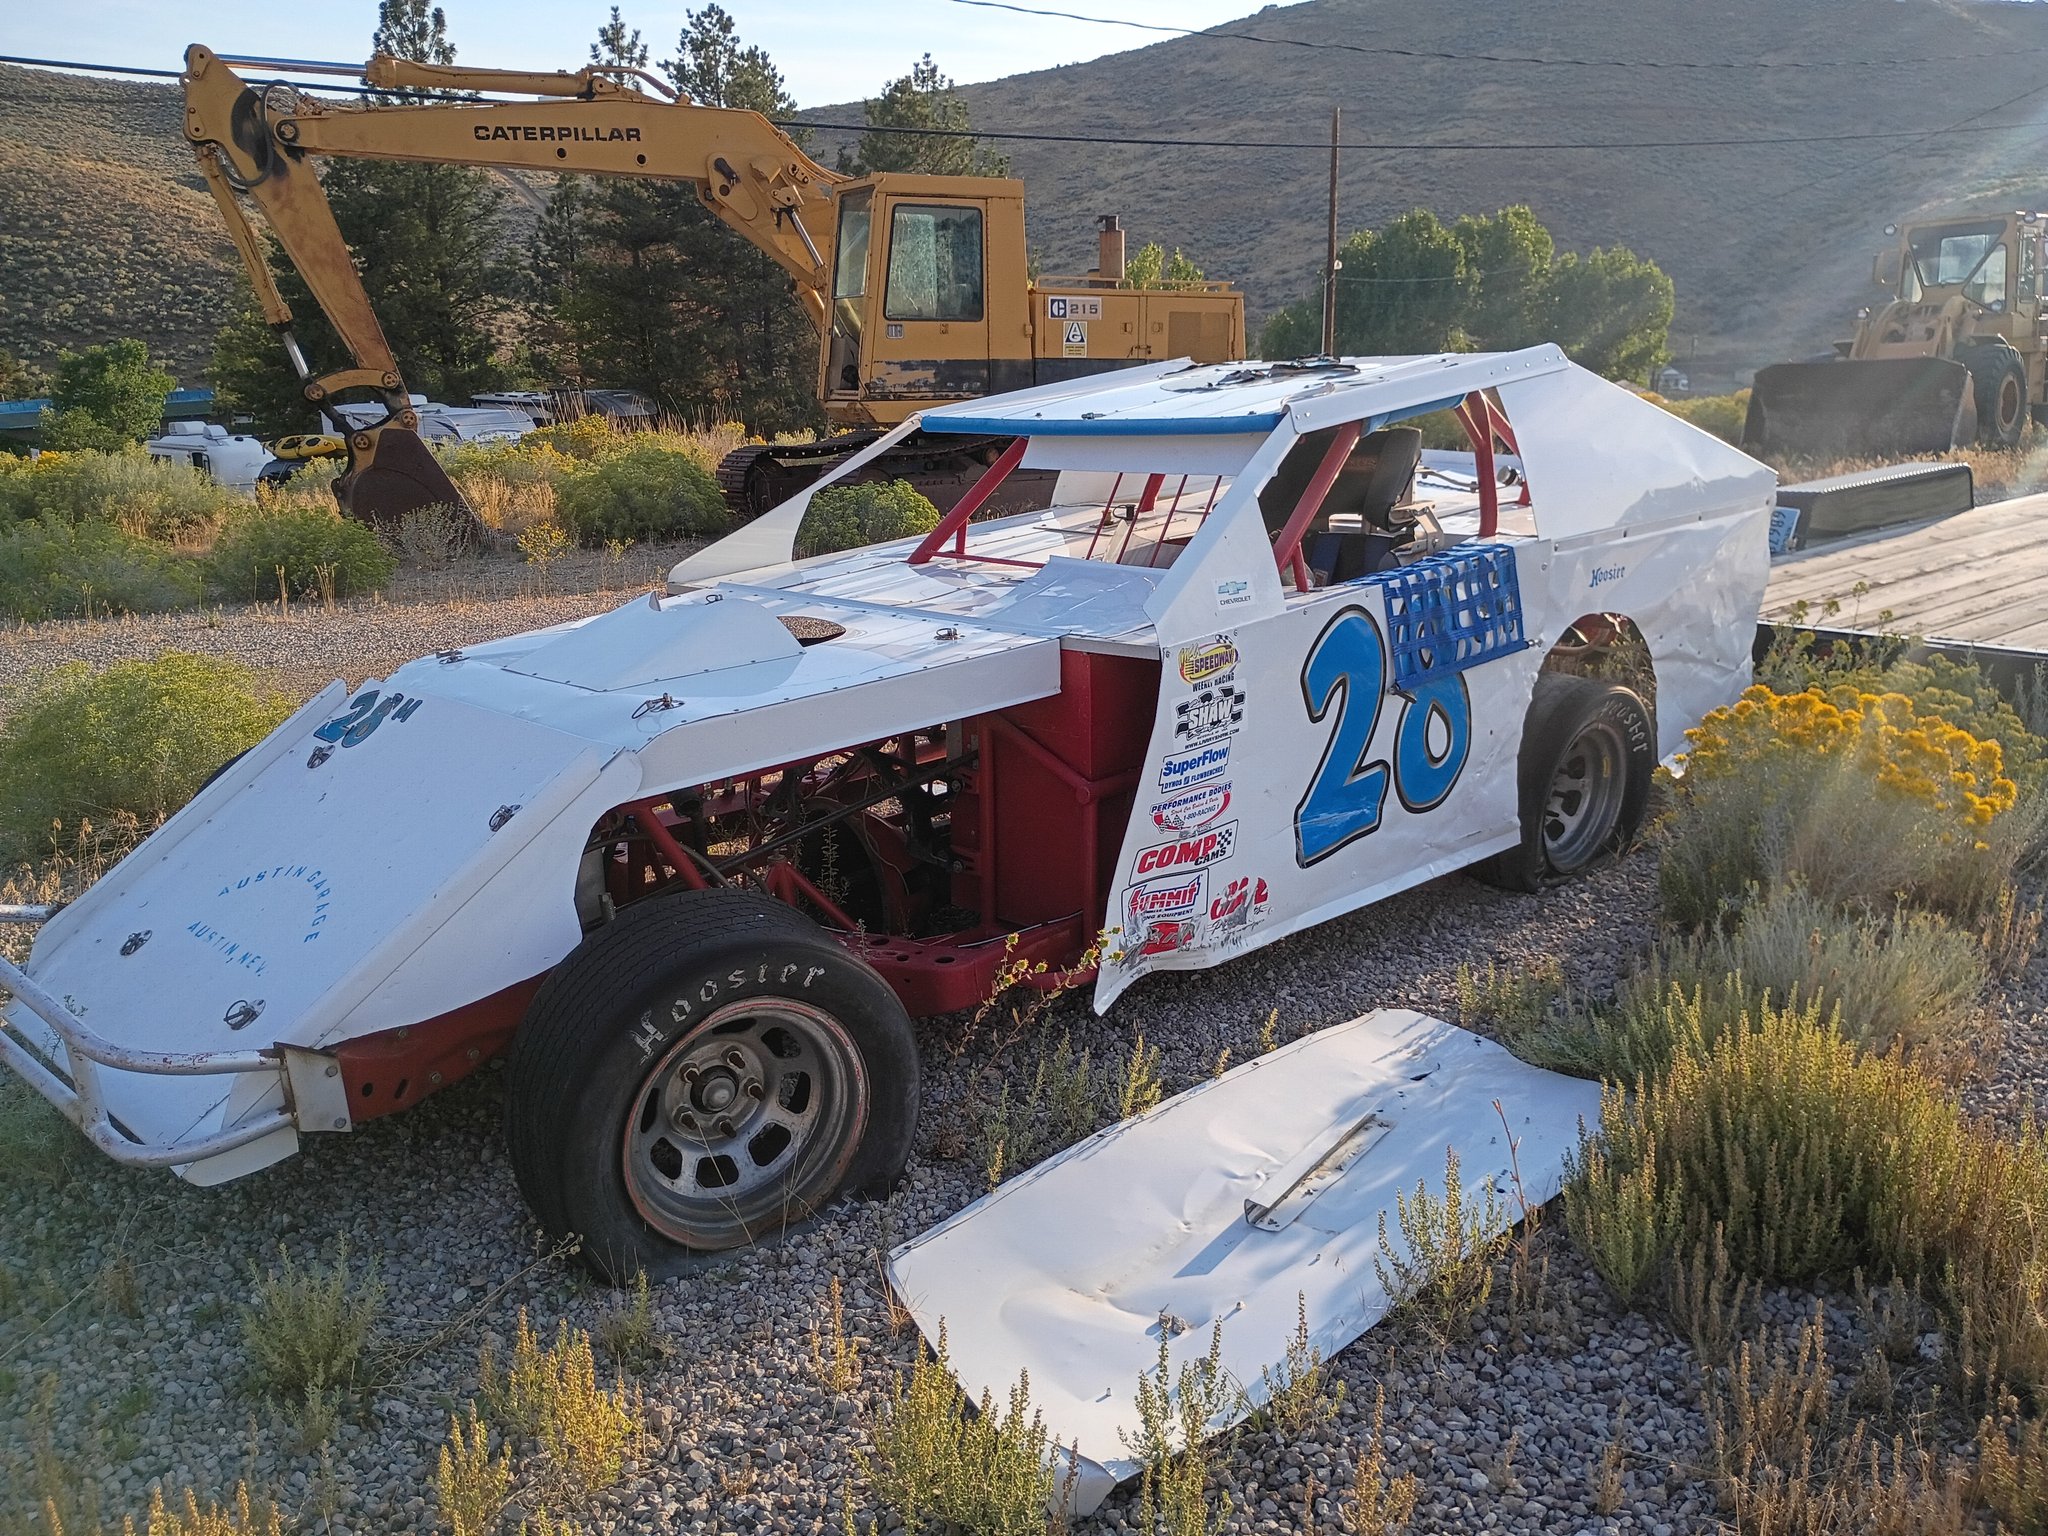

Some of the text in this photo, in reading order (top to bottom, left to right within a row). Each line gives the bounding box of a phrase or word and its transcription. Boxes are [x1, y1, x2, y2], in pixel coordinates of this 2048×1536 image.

[474, 125, 641, 142] CATERPILLAR
[1070, 304, 1098, 314] 215
[1588, 564, 1625, 588] Hoosier
[1220, 596, 1251, 606] CHEVROLET
[1194, 648, 1235, 674] SPEEDWAY
[1193, 672, 1235, 692] WEEKLY RACING
[313, 690, 388, 748] 28
[1188, 698, 1233, 730] SHAW
[1294, 584, 1472, 869] 28
[1599, 699, 1648, 752] Hoosier
[1163, 747, 1228, 777] SuperFlow
[1164, 765, 1224, 790] DYNOS FLOWBENCHES
[1151, 782, 1232, 813] PERFORMANCE BODIES
[1136, 833, 1227, 874] COMP CAMS
[218, 865, 331, 943] AUSTIN GARAGE
[1156, 908, 1194, 919] EQUIPMENT
[630, 962, 826, 1065] Hoosier
